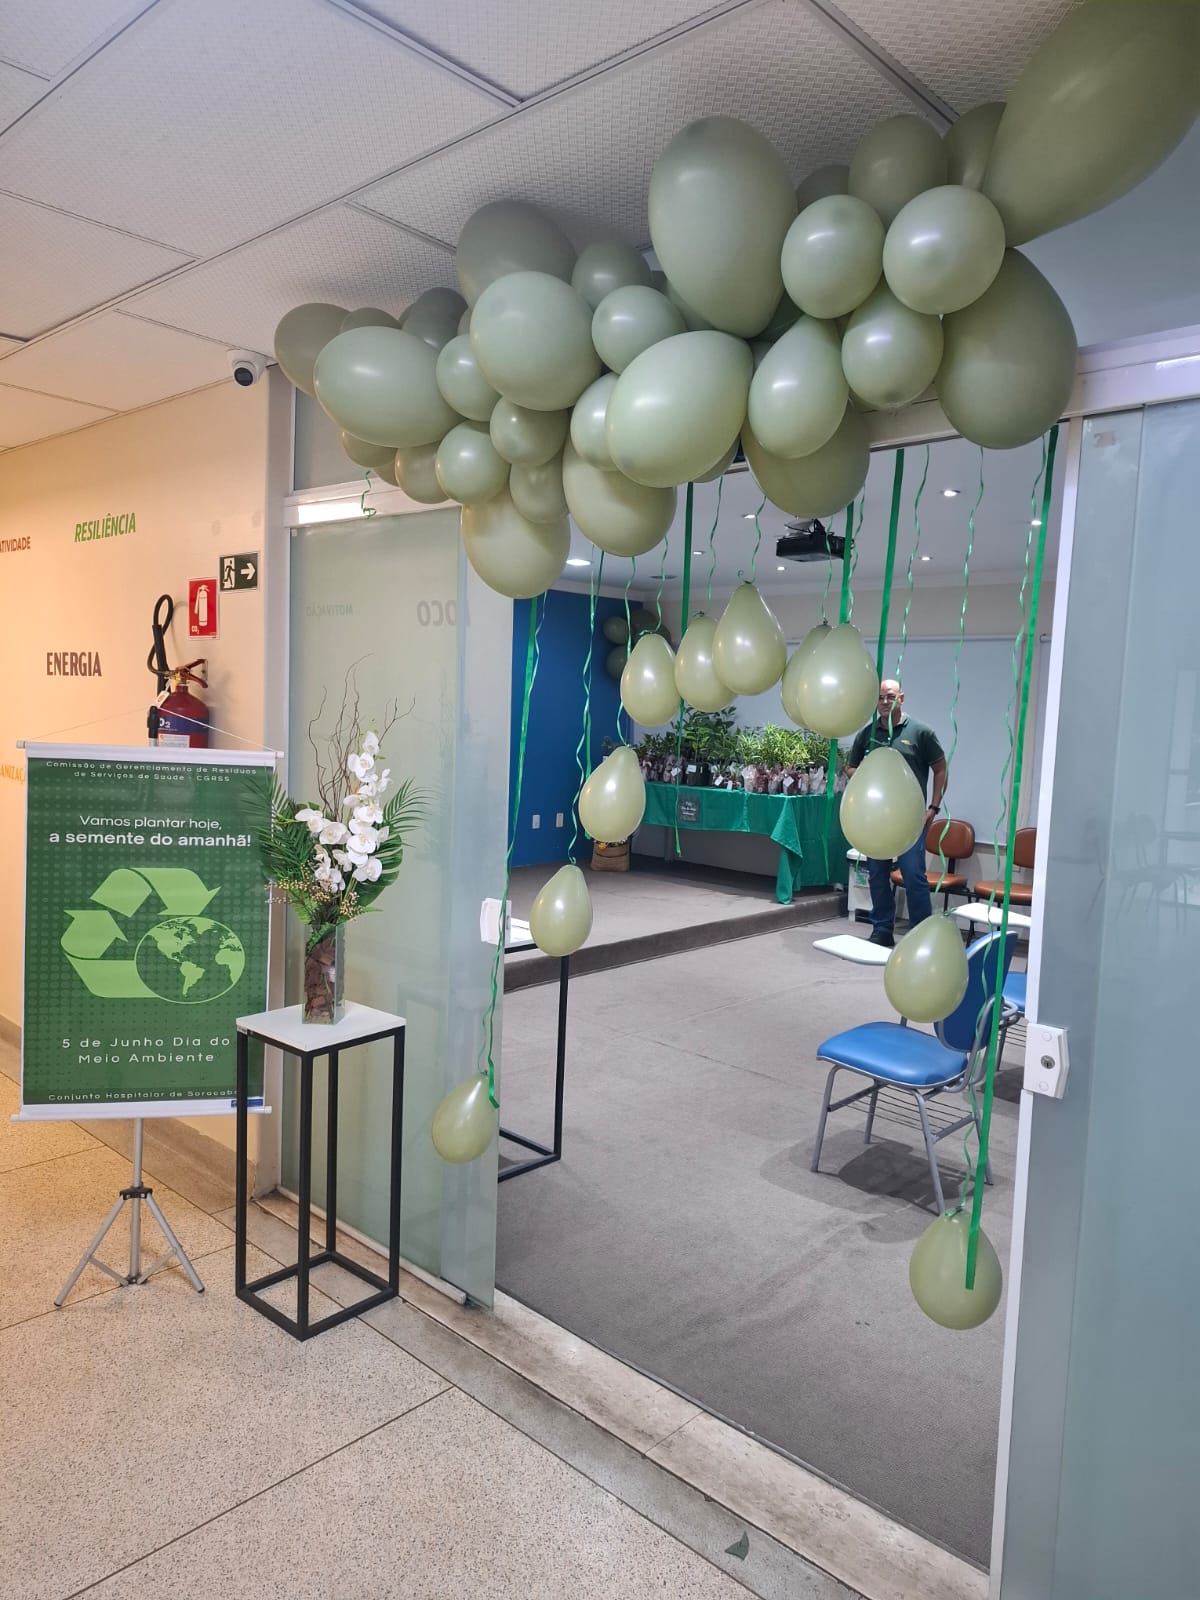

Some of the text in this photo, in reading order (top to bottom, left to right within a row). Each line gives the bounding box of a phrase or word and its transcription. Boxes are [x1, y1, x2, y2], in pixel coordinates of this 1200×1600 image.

[74, 512, 137, 543] RESILIÊNCIA
[46, 651, 102, 677] ENERGIA
[46, 760, 96, 769] Comissão
[115, 763, 193, 773] Gerenciamento
[90, 771, 134, 779] Serviços
[79, 815, 223, 832] Vamos plantar hoje,
[49, 832, 252, 848] a semente do amanhã!
[62, 1036, 231, 1048] 5 de Junho Dia do
[78, 1052, 214, 1064] Meio Ambiente
[48, 1088, 237, 1102] Conjunto Hospitalar de Sorocab
